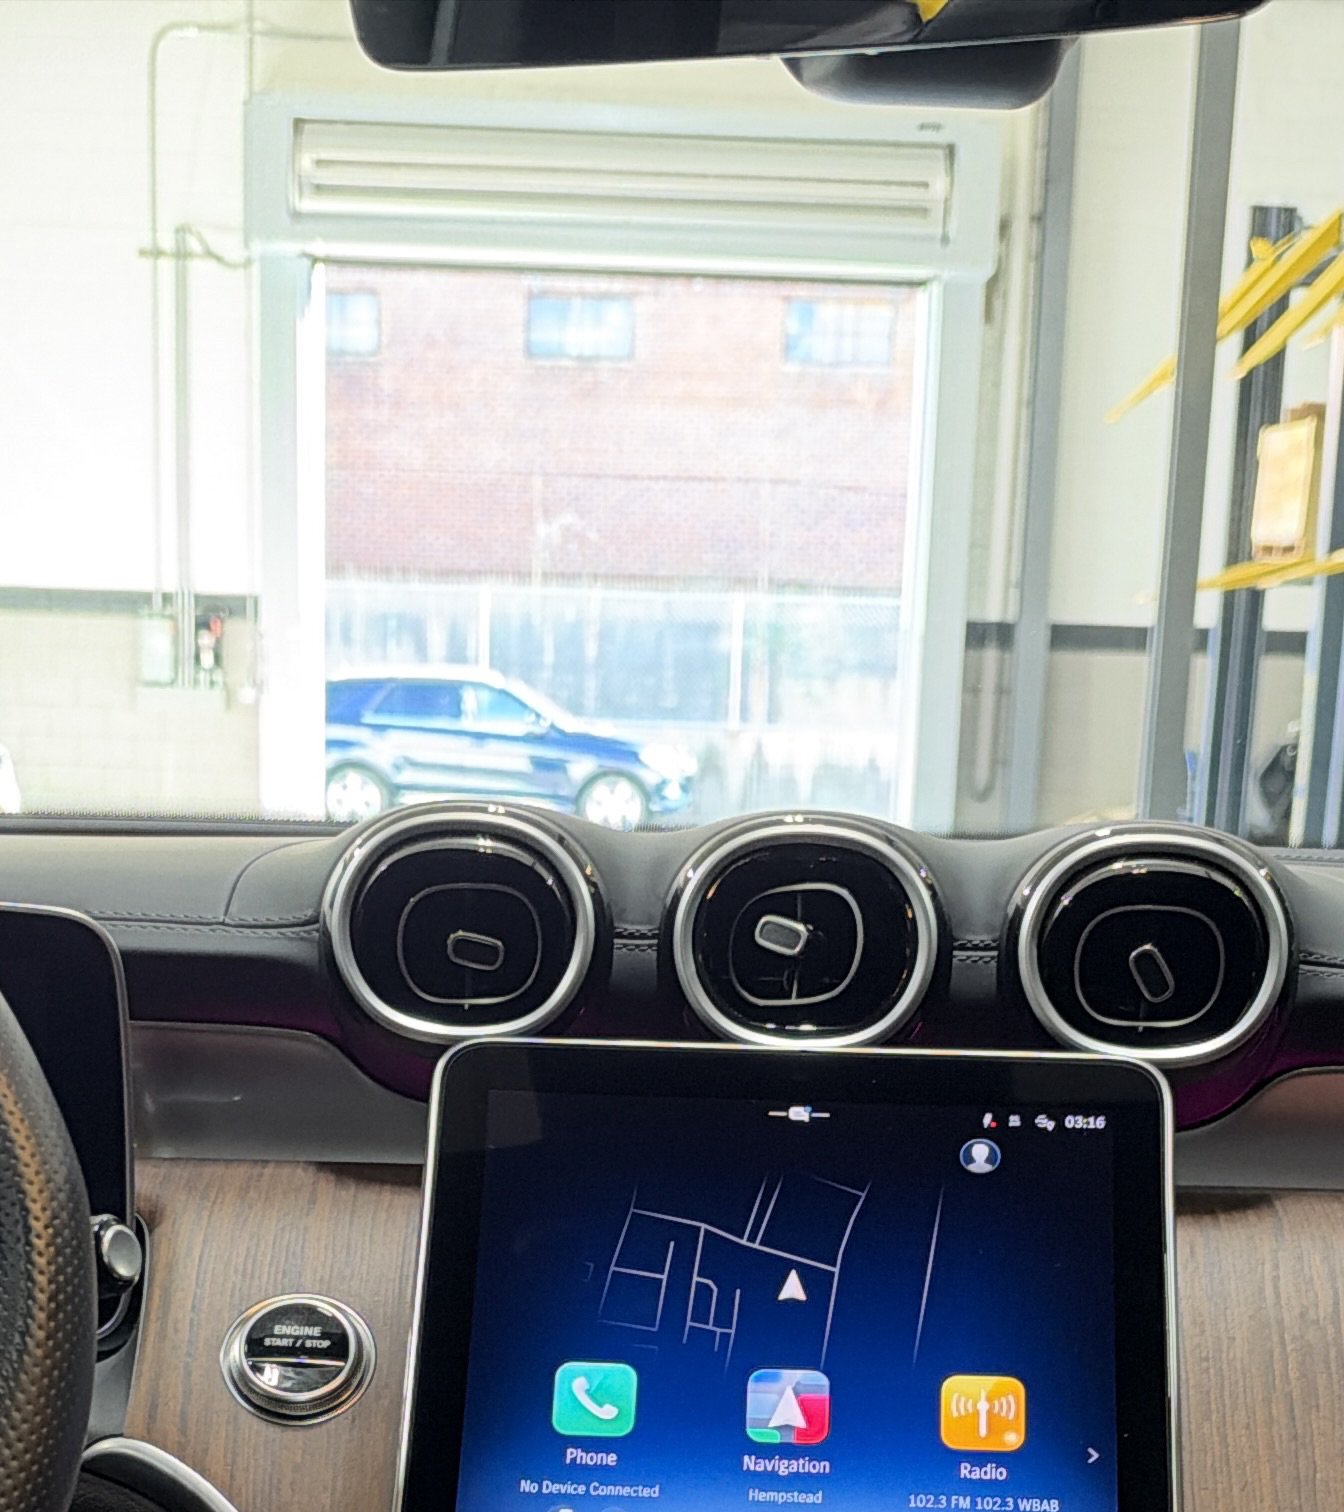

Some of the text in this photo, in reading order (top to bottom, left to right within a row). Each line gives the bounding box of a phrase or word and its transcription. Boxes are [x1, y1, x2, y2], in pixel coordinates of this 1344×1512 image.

[1064, 1115, 1106, 1129] 03:16
[274, 1325, 322, 1336] ENGINE
[264, 1338, 293, 1347] START
[305, 1339, 331, 1348] STOP
[565, 1447, 618, 1466] Phone
[743, 1454, 830, 1476] Navigation
[960, 1462, 1007, 1481] Radio
[519, 1479, 660, 1499] No Device Connected
[748, 1488, 823, 1506] Hempstead
[908, 1493, 947, 1510] 102.3
[950, 1495, 972, 1510] FM
[975, 1496, 1015, 1512] 102.3
